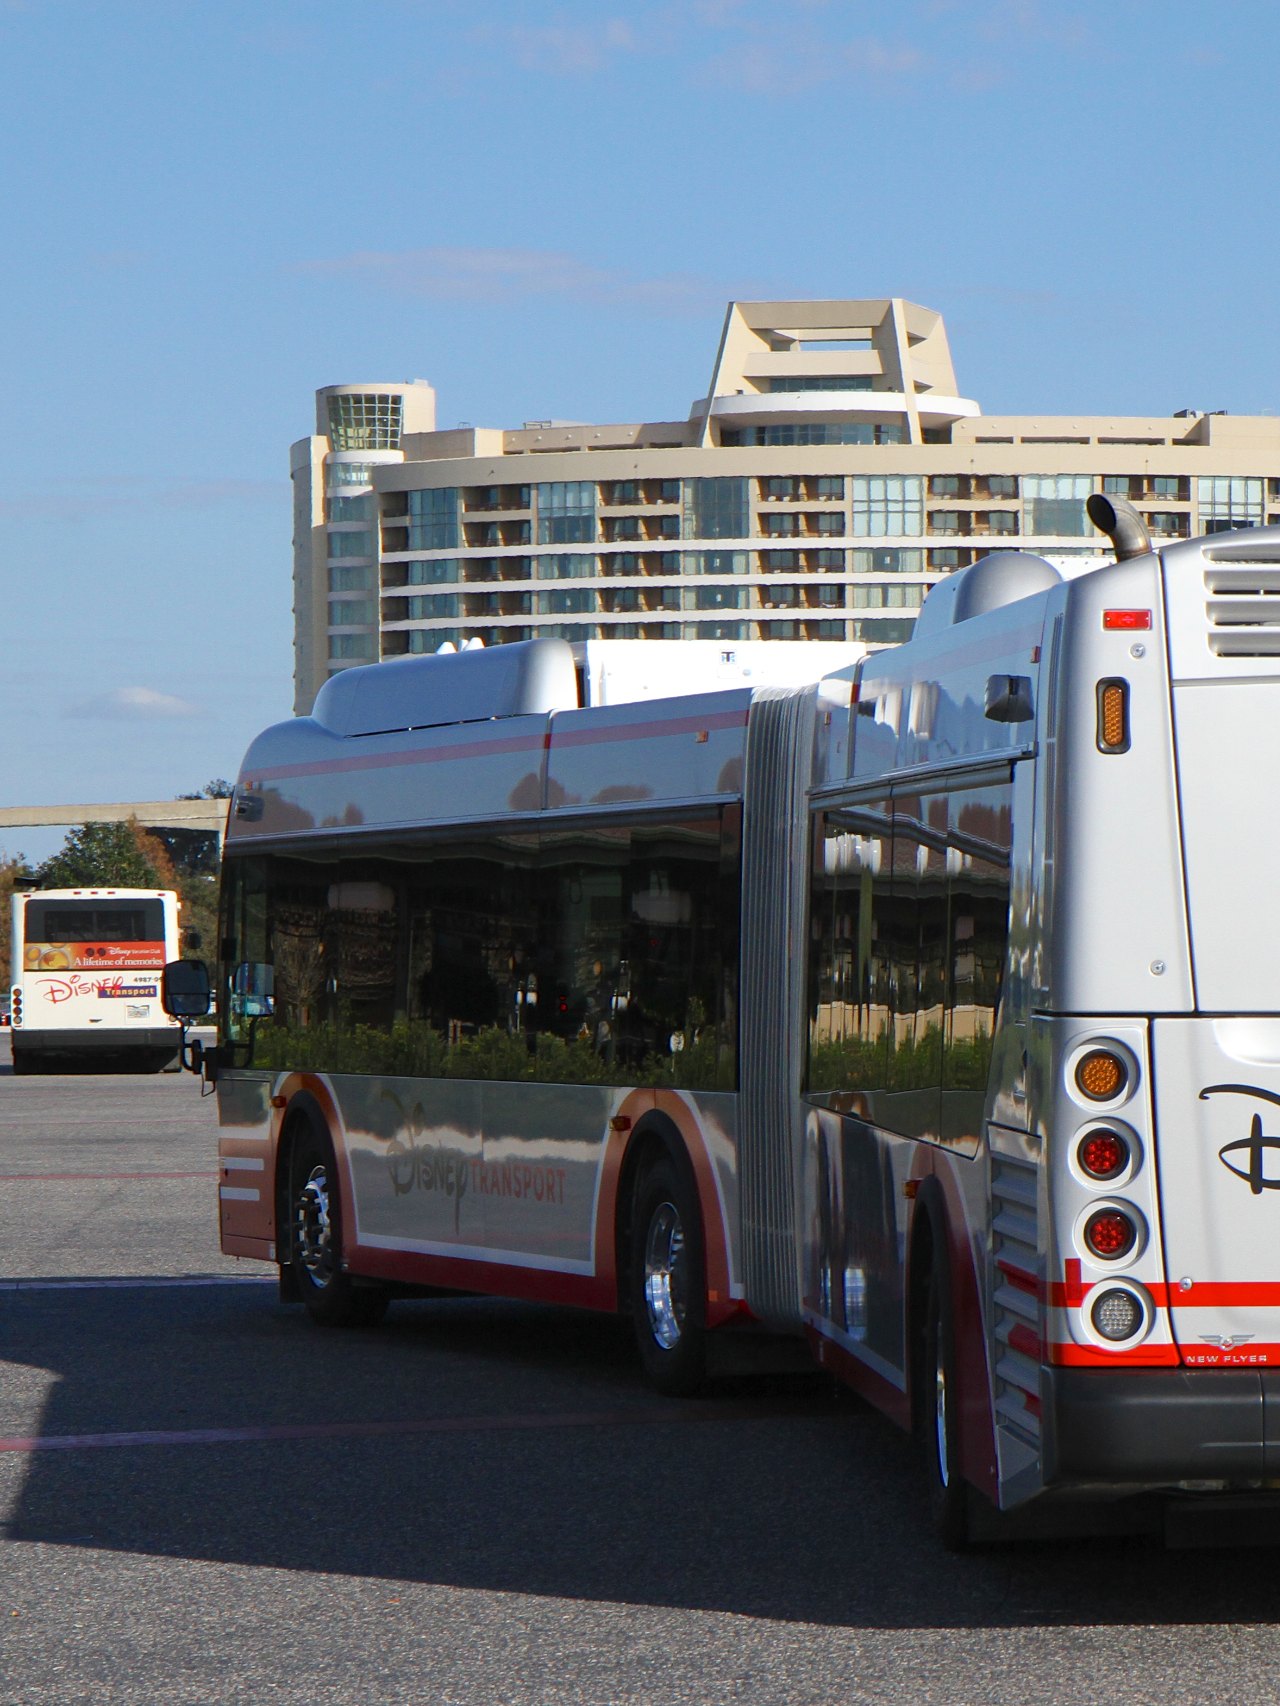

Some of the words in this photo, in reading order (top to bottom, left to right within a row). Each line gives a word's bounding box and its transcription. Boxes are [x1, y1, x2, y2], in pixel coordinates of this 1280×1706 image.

[74, 958, 81, 966] A
[82, 957, 113, 966] lifetime
[114, 957, 124, 966] of
[105, 987, 155, 996] Transport
[470, 1158, 567, 1205] TRANSPORT
[1186, 1355, 1219, 1363] NEW
[1223, 1354, 1267, 1363] FLYER
